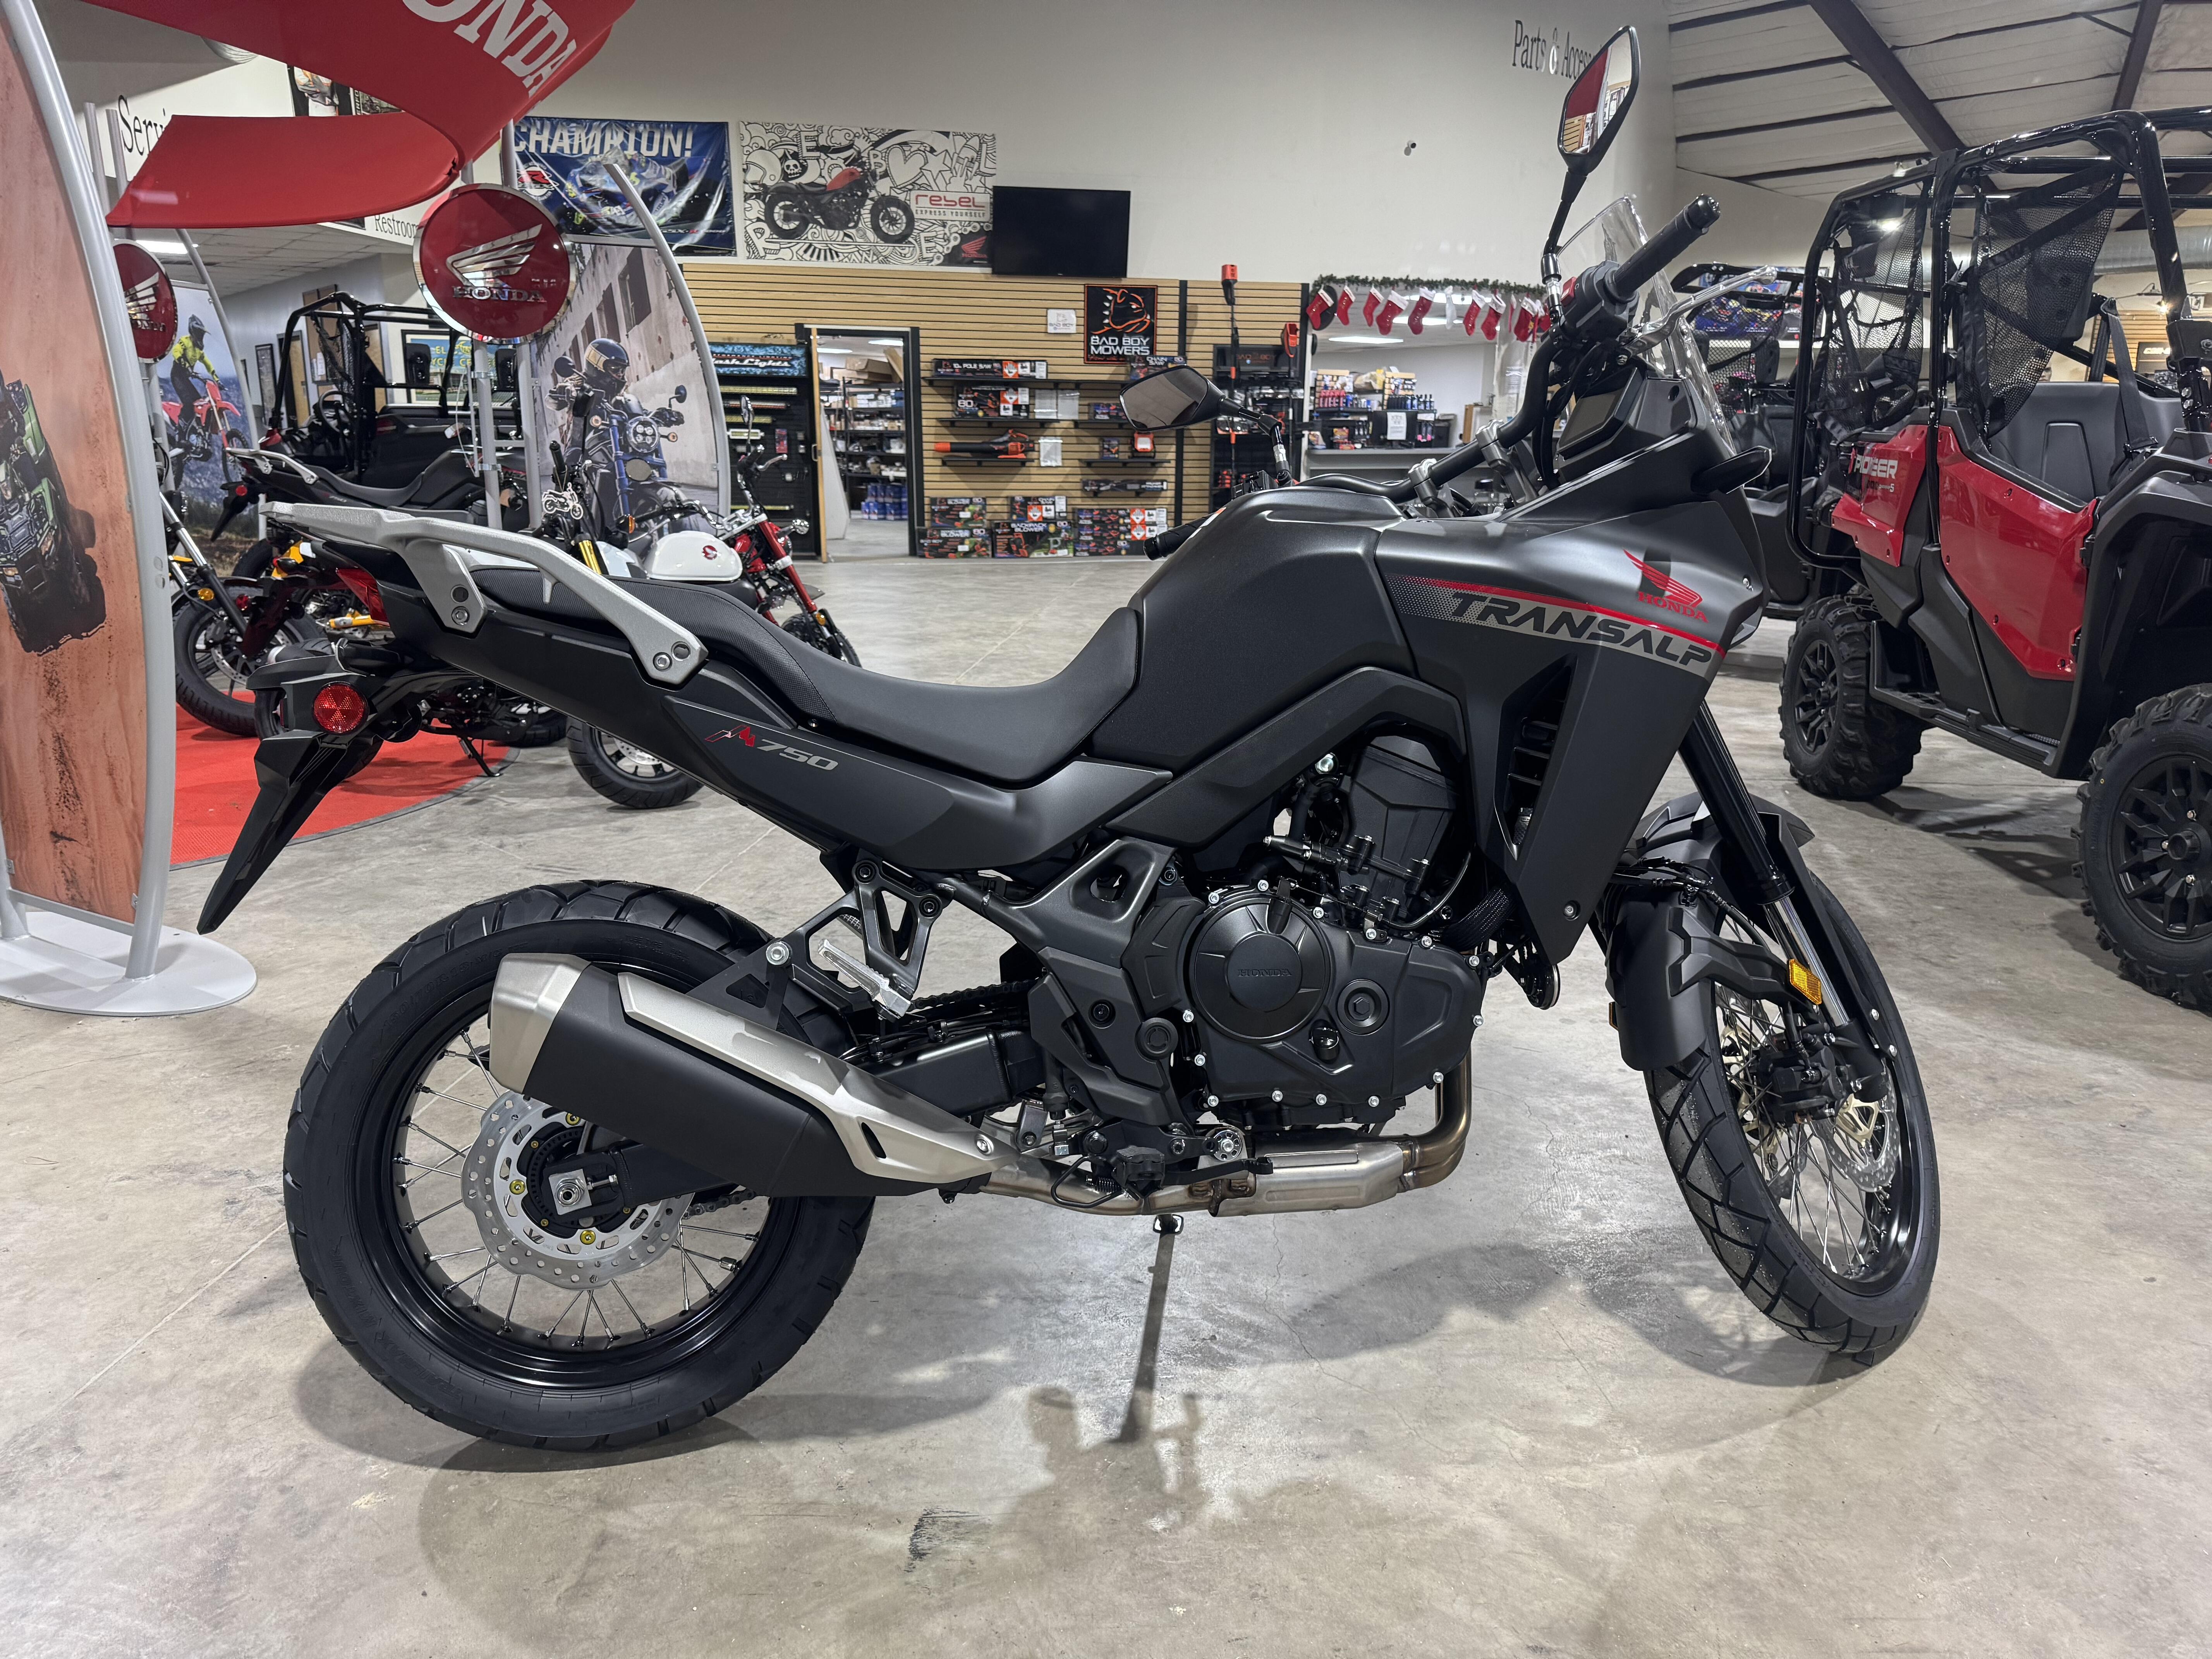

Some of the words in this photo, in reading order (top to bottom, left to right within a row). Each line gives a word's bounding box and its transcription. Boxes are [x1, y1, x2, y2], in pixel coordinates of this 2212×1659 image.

[1512, 20, 1546, 72] Parts
[1561, 31, 1602, 80] Acces
[514, 121, 693, 157] CHAMPION!
[452, 286, 547, 303] HONDA
[1090, 335, 1118, 345] BAD
[1122, 337, 1150, 346] BOY
[1090, 345, 1150, 356] MOWERS
[1637, 591, 1709, 623] HONDA
[1449, 592, 1712, 666] TRANSALP
[757, 738, 839, 770] 750
[1238, 969, 1293, 977] HONDA
